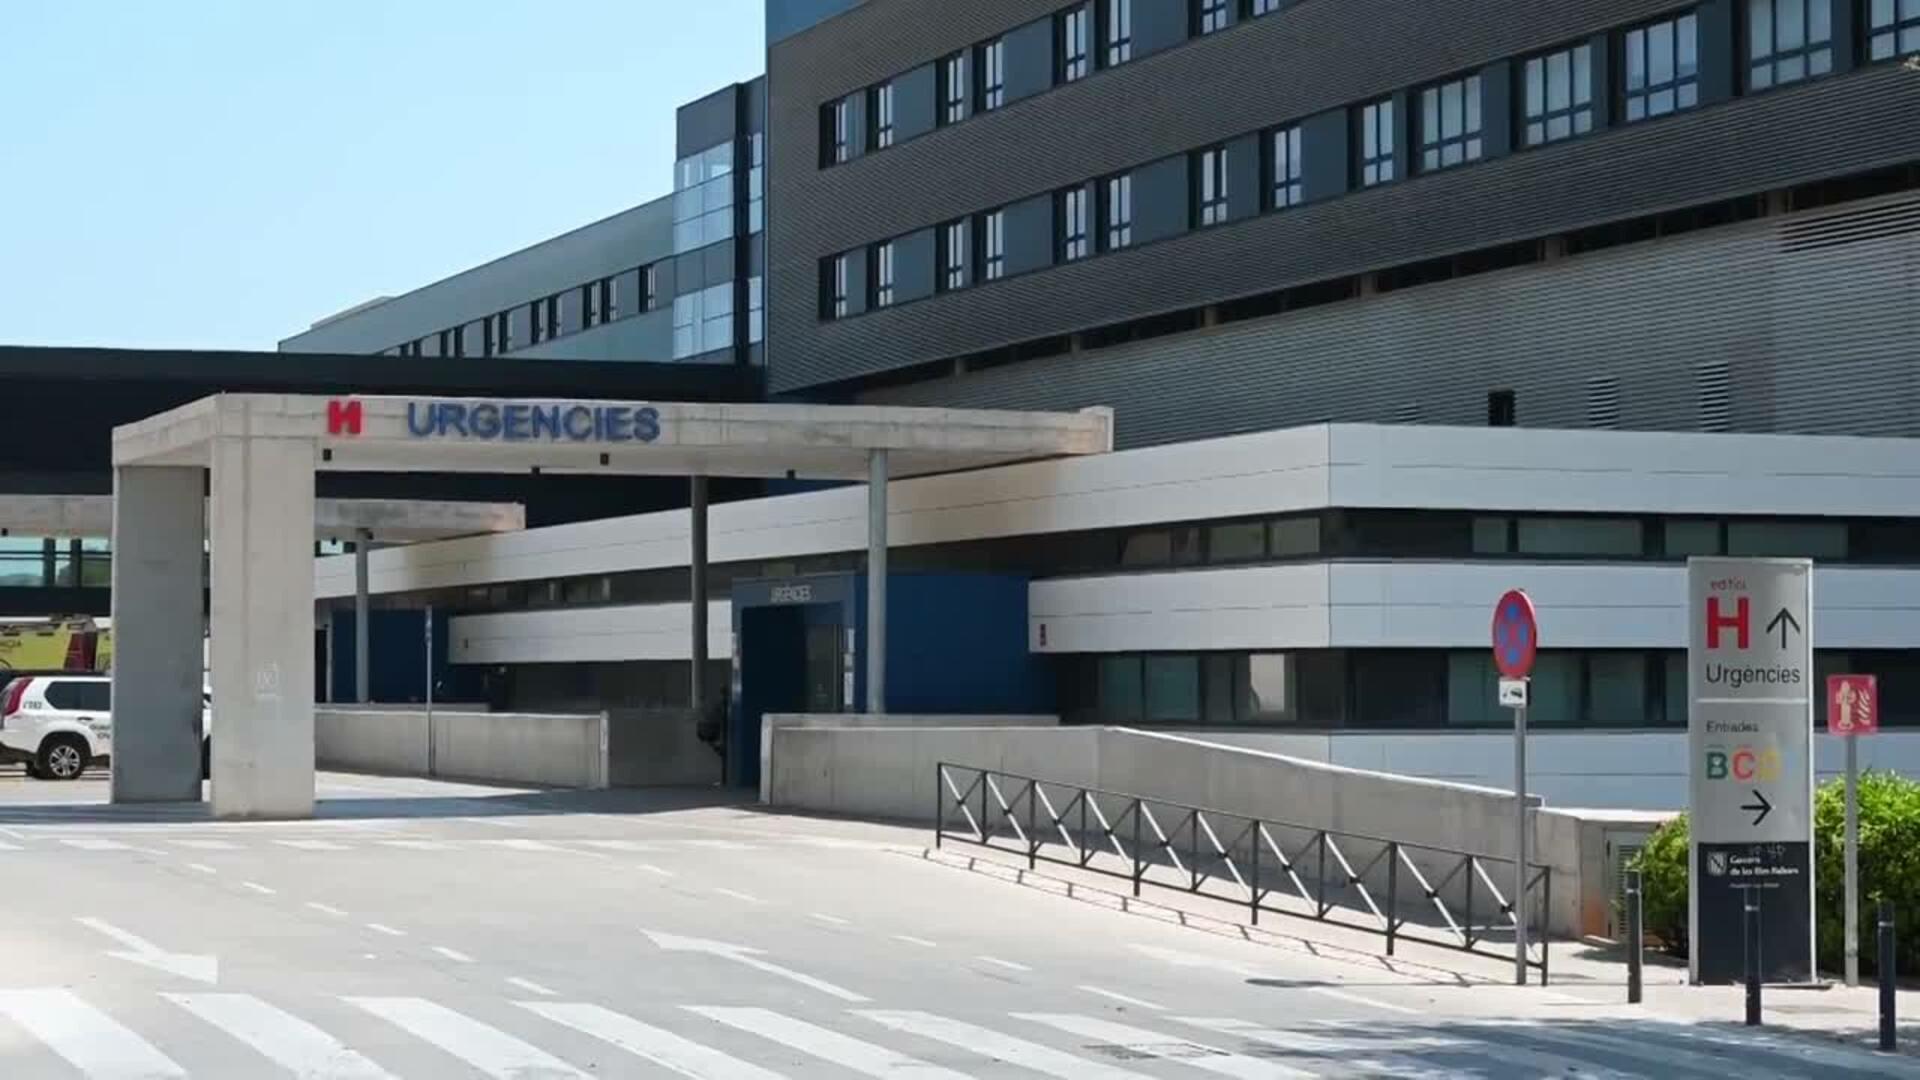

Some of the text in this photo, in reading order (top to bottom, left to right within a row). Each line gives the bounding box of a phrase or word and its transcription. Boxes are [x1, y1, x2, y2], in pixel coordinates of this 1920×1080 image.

[407, 402, 660, 442] URGENCIES
[1707, 597, 1749, 648] H
[1707, 721, 1758, 732] Entrades
